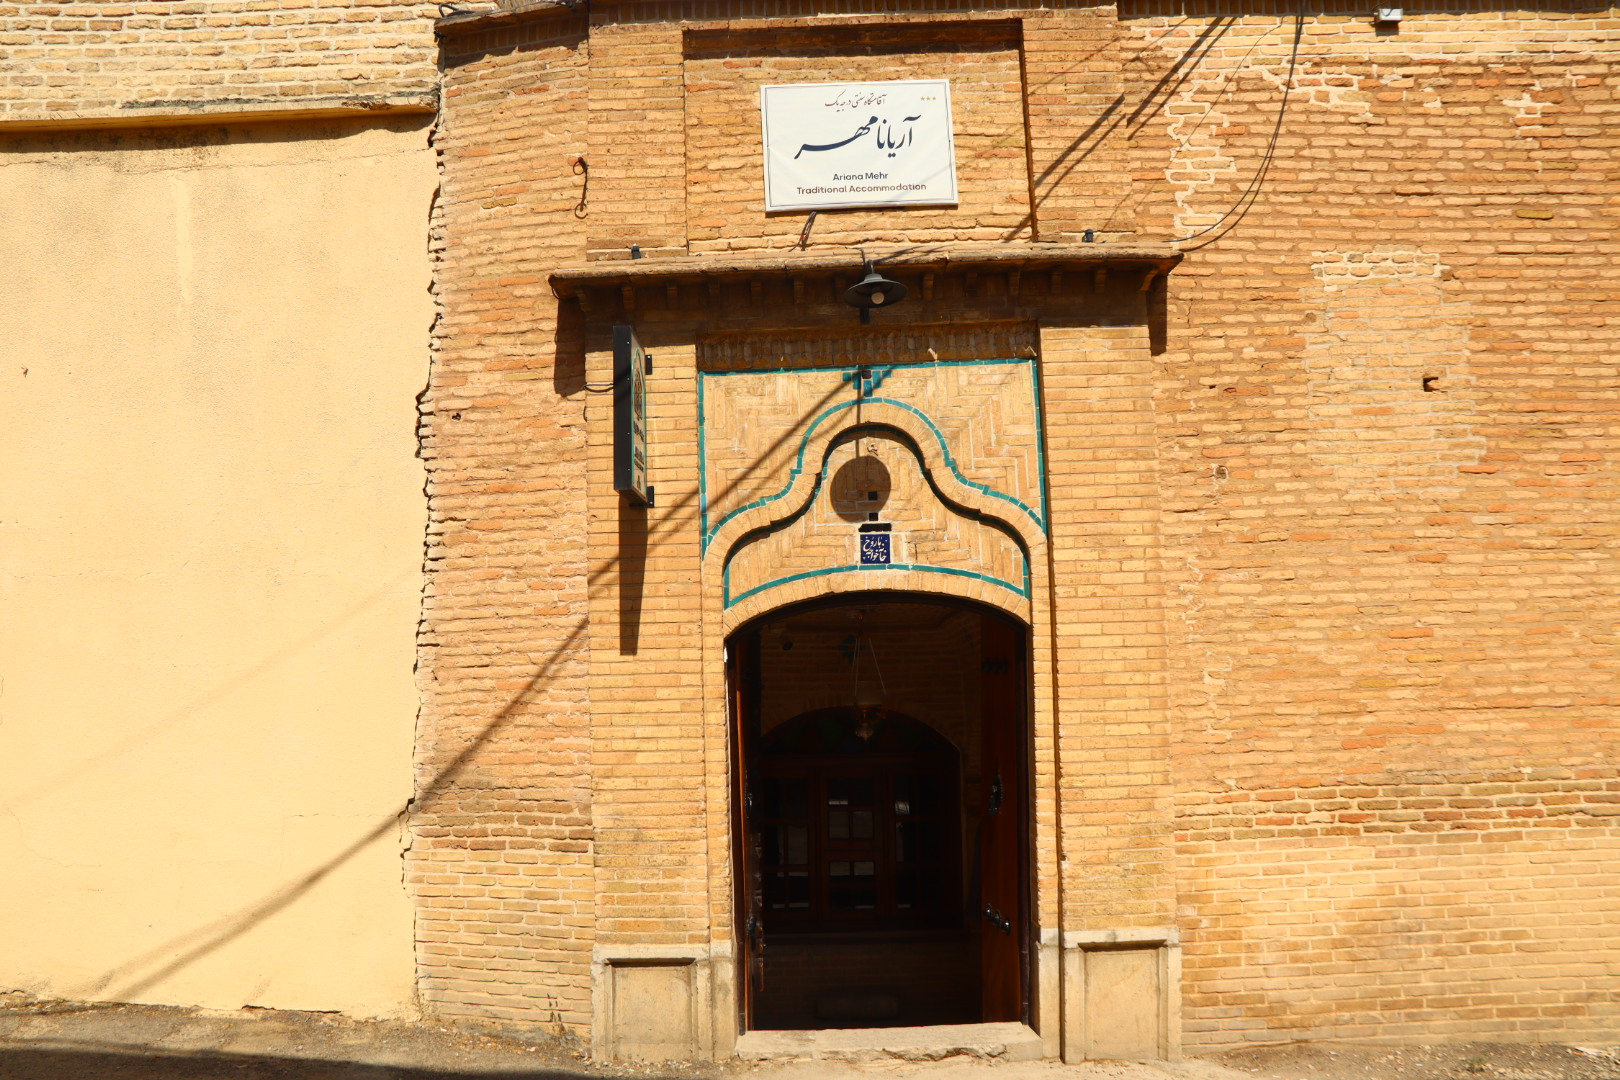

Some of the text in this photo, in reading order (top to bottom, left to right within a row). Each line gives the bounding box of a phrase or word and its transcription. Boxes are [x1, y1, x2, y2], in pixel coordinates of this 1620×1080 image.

[825, 90, 847, 112] یک
[839, 99, 852, 111] درجه
[851, 92, 866, 108] سنتی
[793, 114, 922, 160] آریانا مهر
[832, 171, 889, 181] Ariana Mehr
[797, 183, 927, 195] Traditional Accommodation
